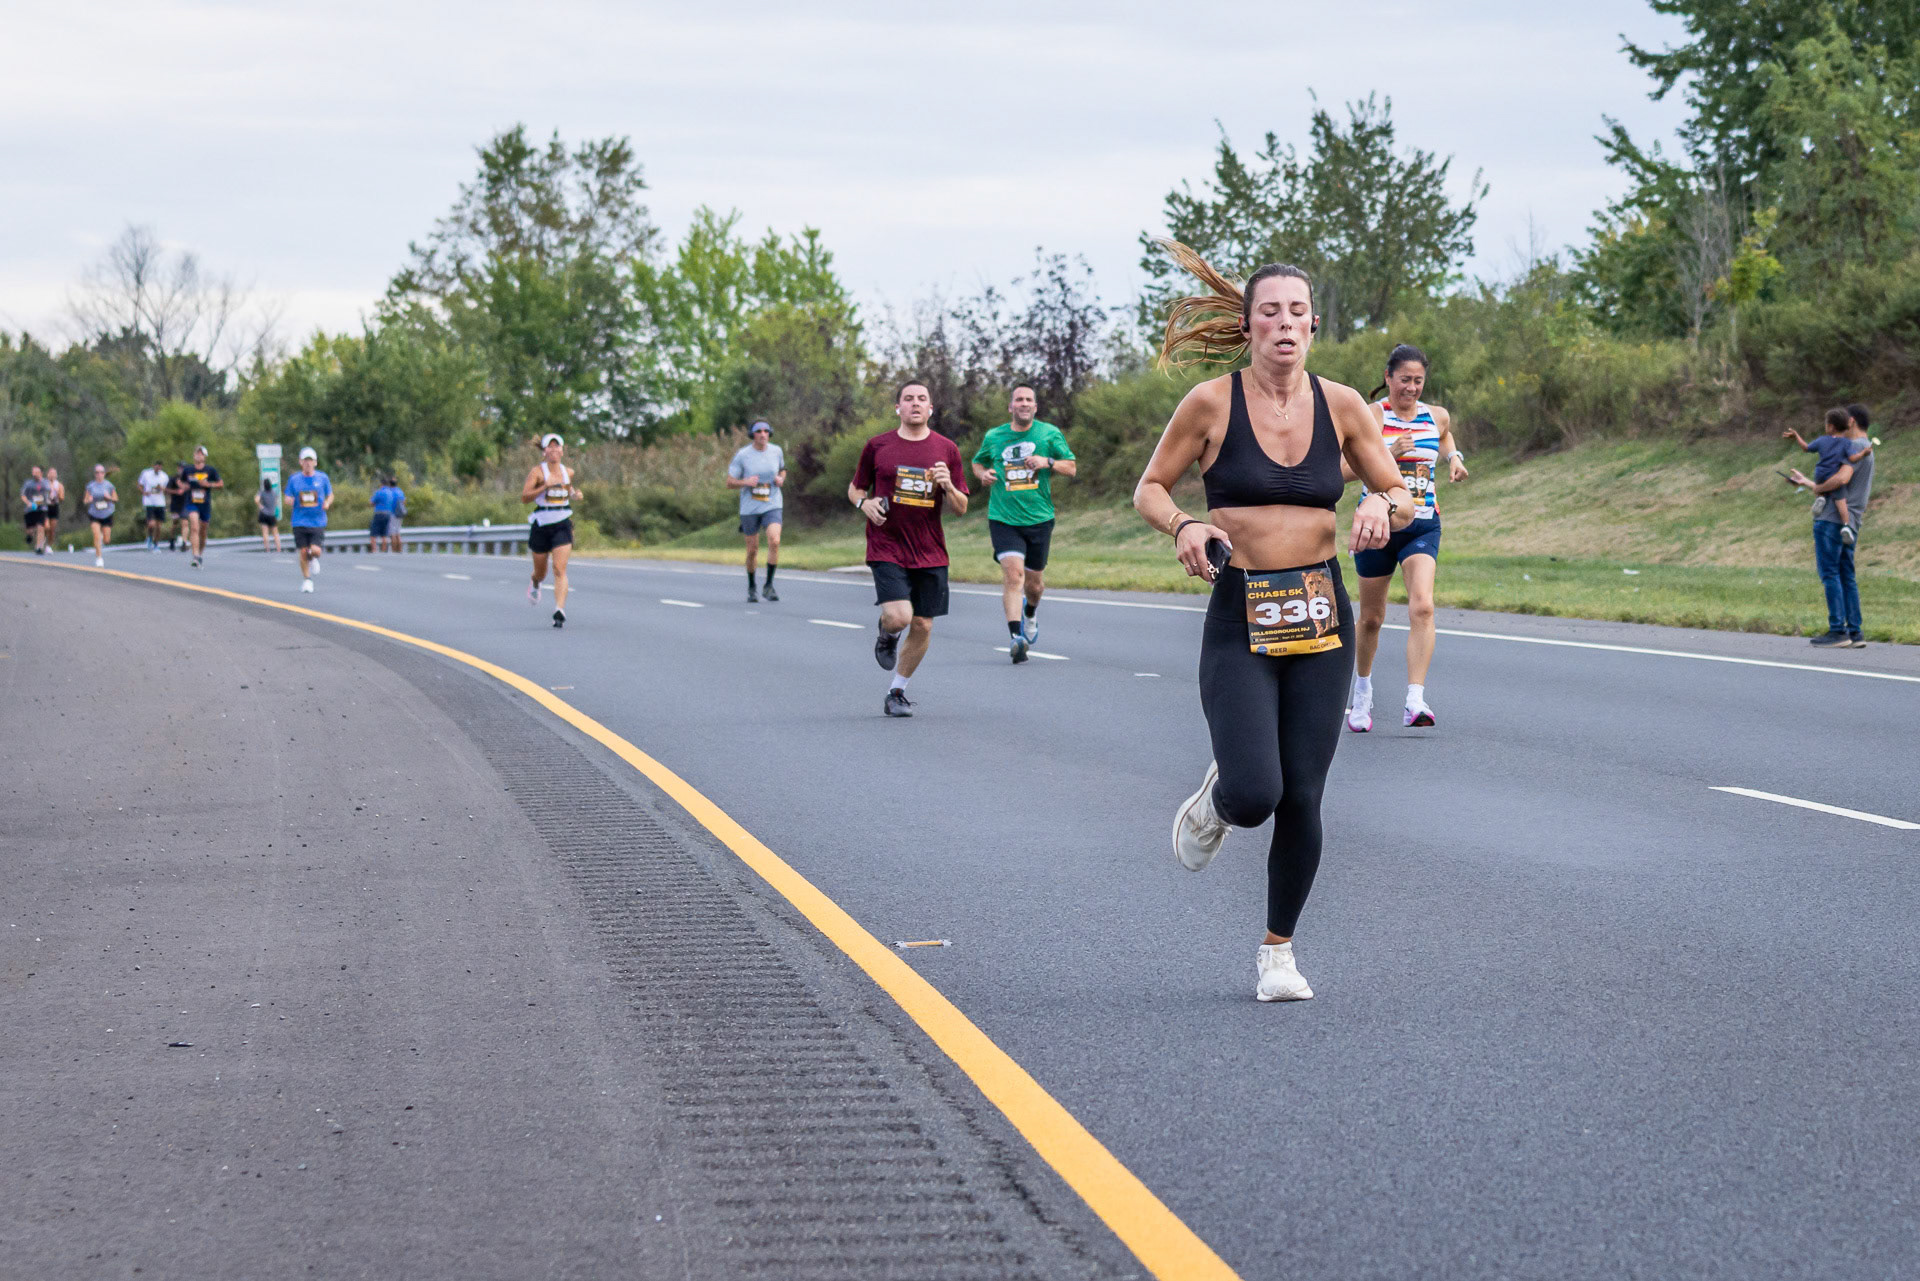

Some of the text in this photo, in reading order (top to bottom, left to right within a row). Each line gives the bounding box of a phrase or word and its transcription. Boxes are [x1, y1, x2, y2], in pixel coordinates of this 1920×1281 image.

[901, 478, 933, 493] 231
[1248, 588, 1304, 599] CHASE 5K
[1255, 597, 1330, 625] 336
